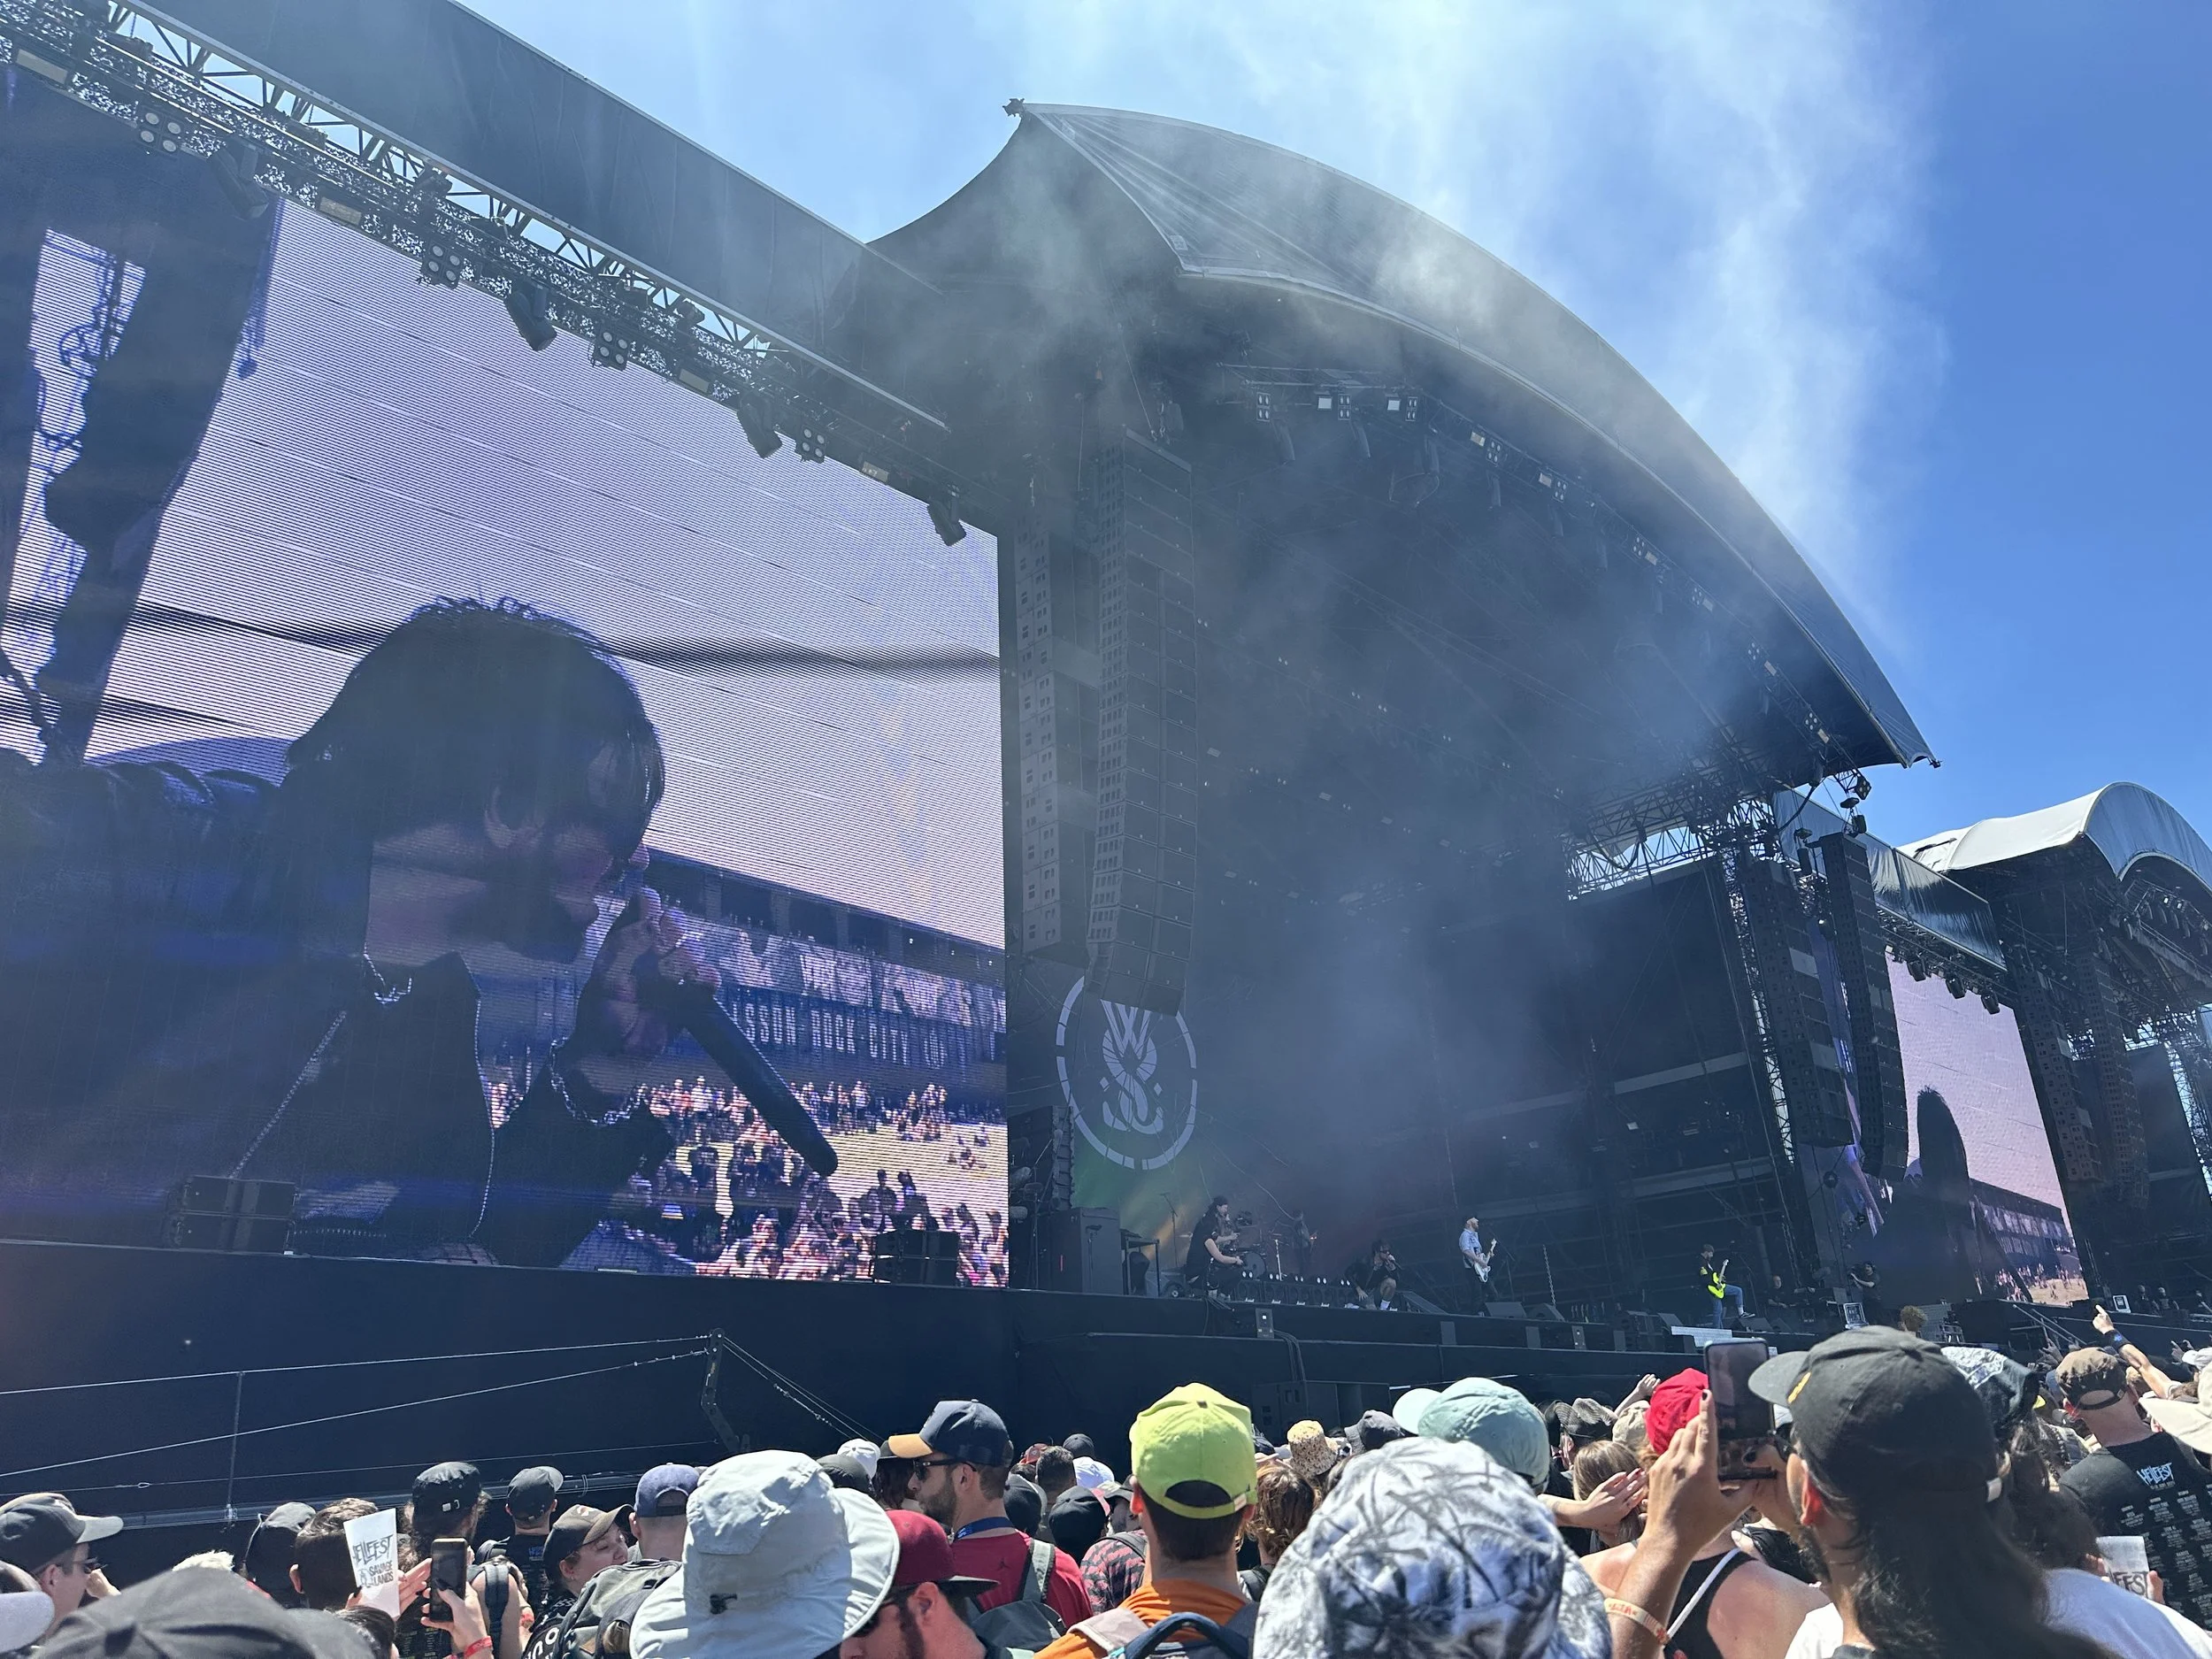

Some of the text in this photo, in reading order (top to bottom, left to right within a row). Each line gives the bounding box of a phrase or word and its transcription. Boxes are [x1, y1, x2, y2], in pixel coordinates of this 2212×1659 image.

[811, 1010, 856, 1054] ROCK
[868, 1017, 908, 1065] CITY
[2136, 1462, 2174, 1486] HELLFEST
